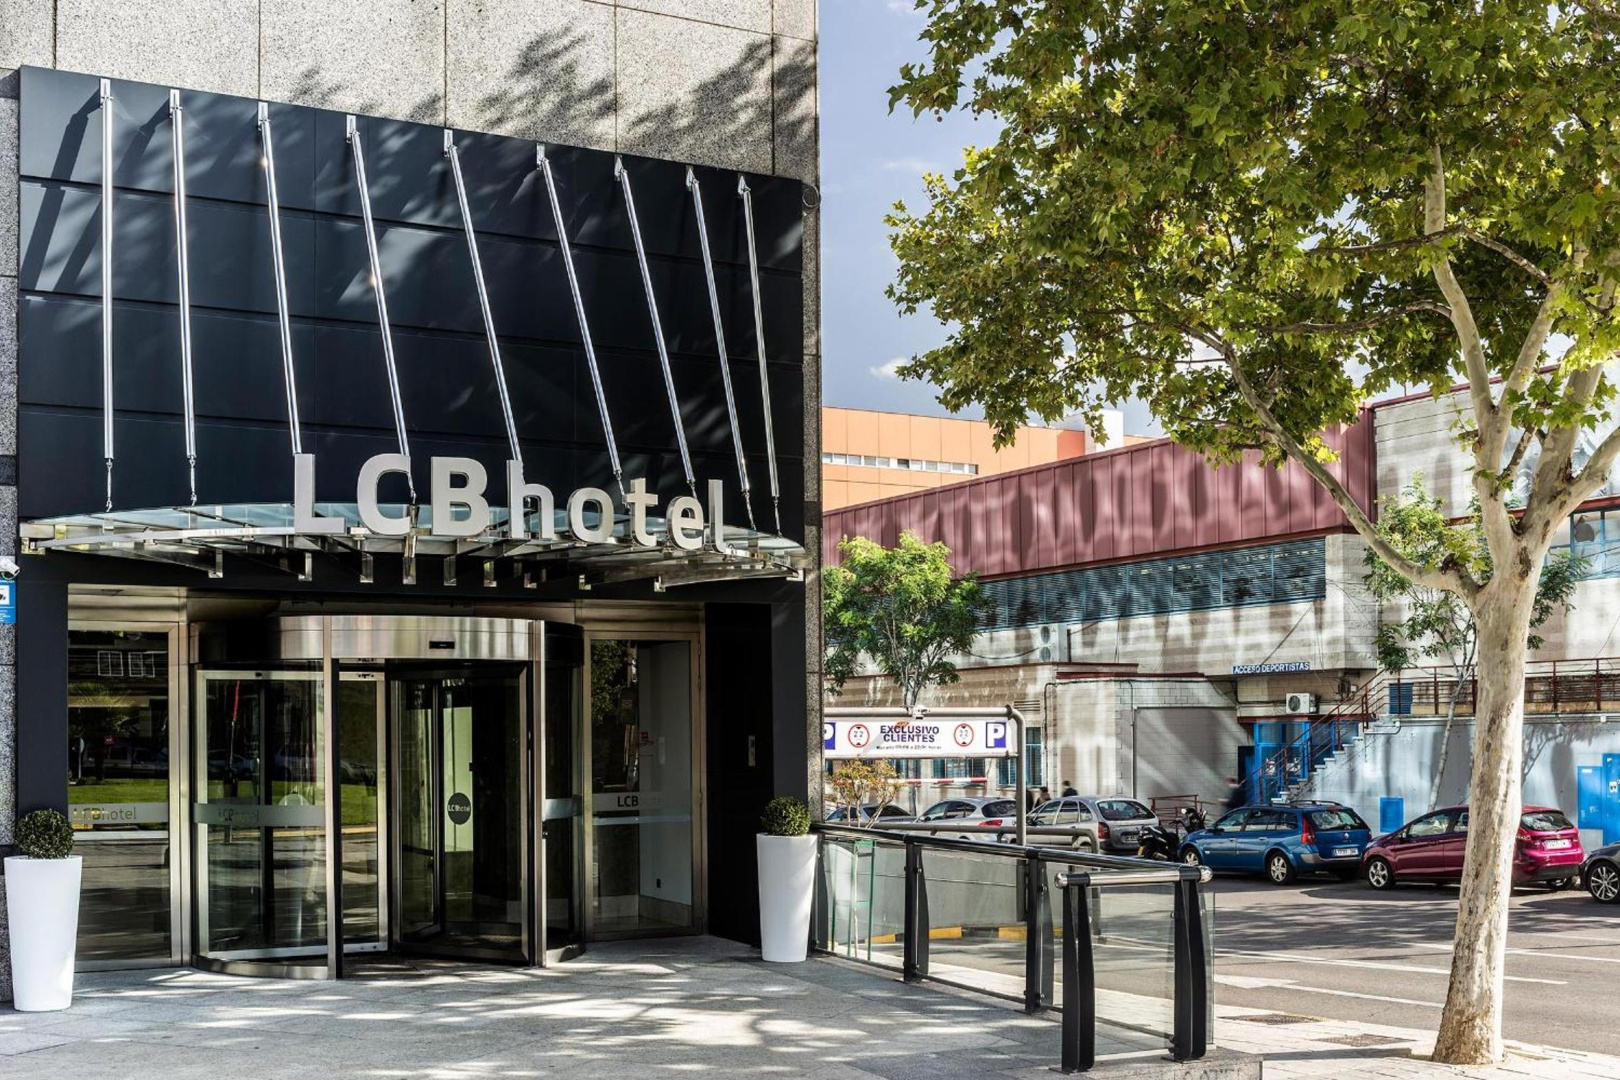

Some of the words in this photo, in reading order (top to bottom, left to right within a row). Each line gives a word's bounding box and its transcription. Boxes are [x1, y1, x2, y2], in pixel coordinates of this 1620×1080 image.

[293, 453, 727, 553] LCBhotel
[1234, 665, 1260, 674] ACCESO
[1261, 662, 1310, 673] DEPORTISTAS
[880, 725, 940, 734] EXCLUSIVO
[987, 723, 1004, 747] P
[883, 733, 935, 743] CLIENTES
